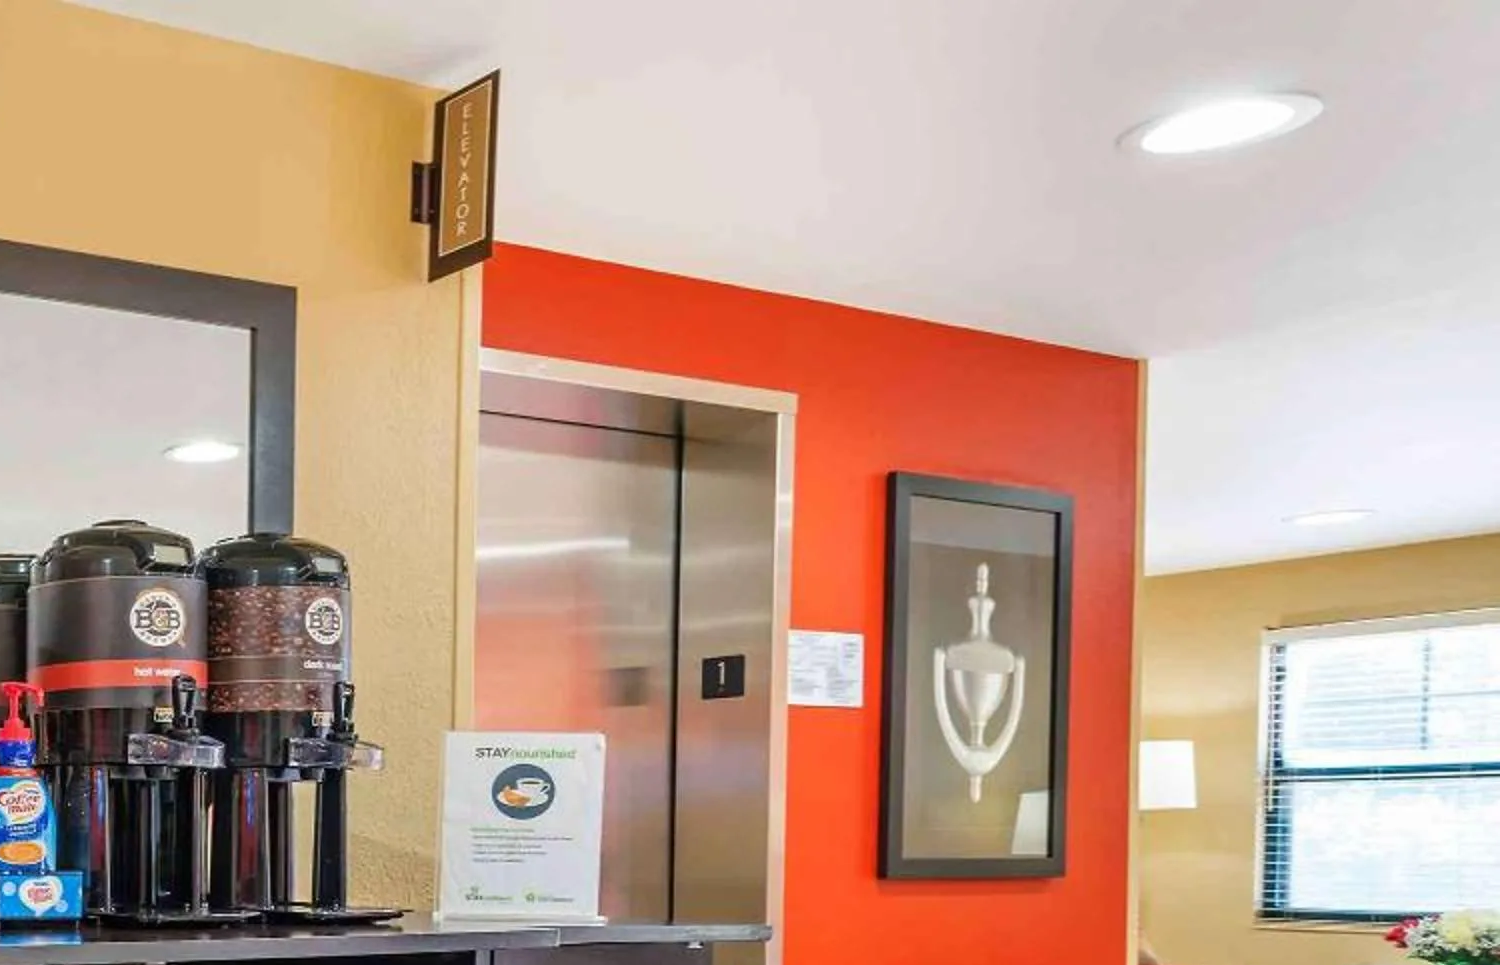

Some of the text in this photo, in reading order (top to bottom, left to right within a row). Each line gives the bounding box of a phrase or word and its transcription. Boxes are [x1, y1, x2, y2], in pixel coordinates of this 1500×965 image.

[455, 103, 473, 236] ELEVATOR
[133, 667, 153, 677] hot
[717, 661, 725, 685] 1
